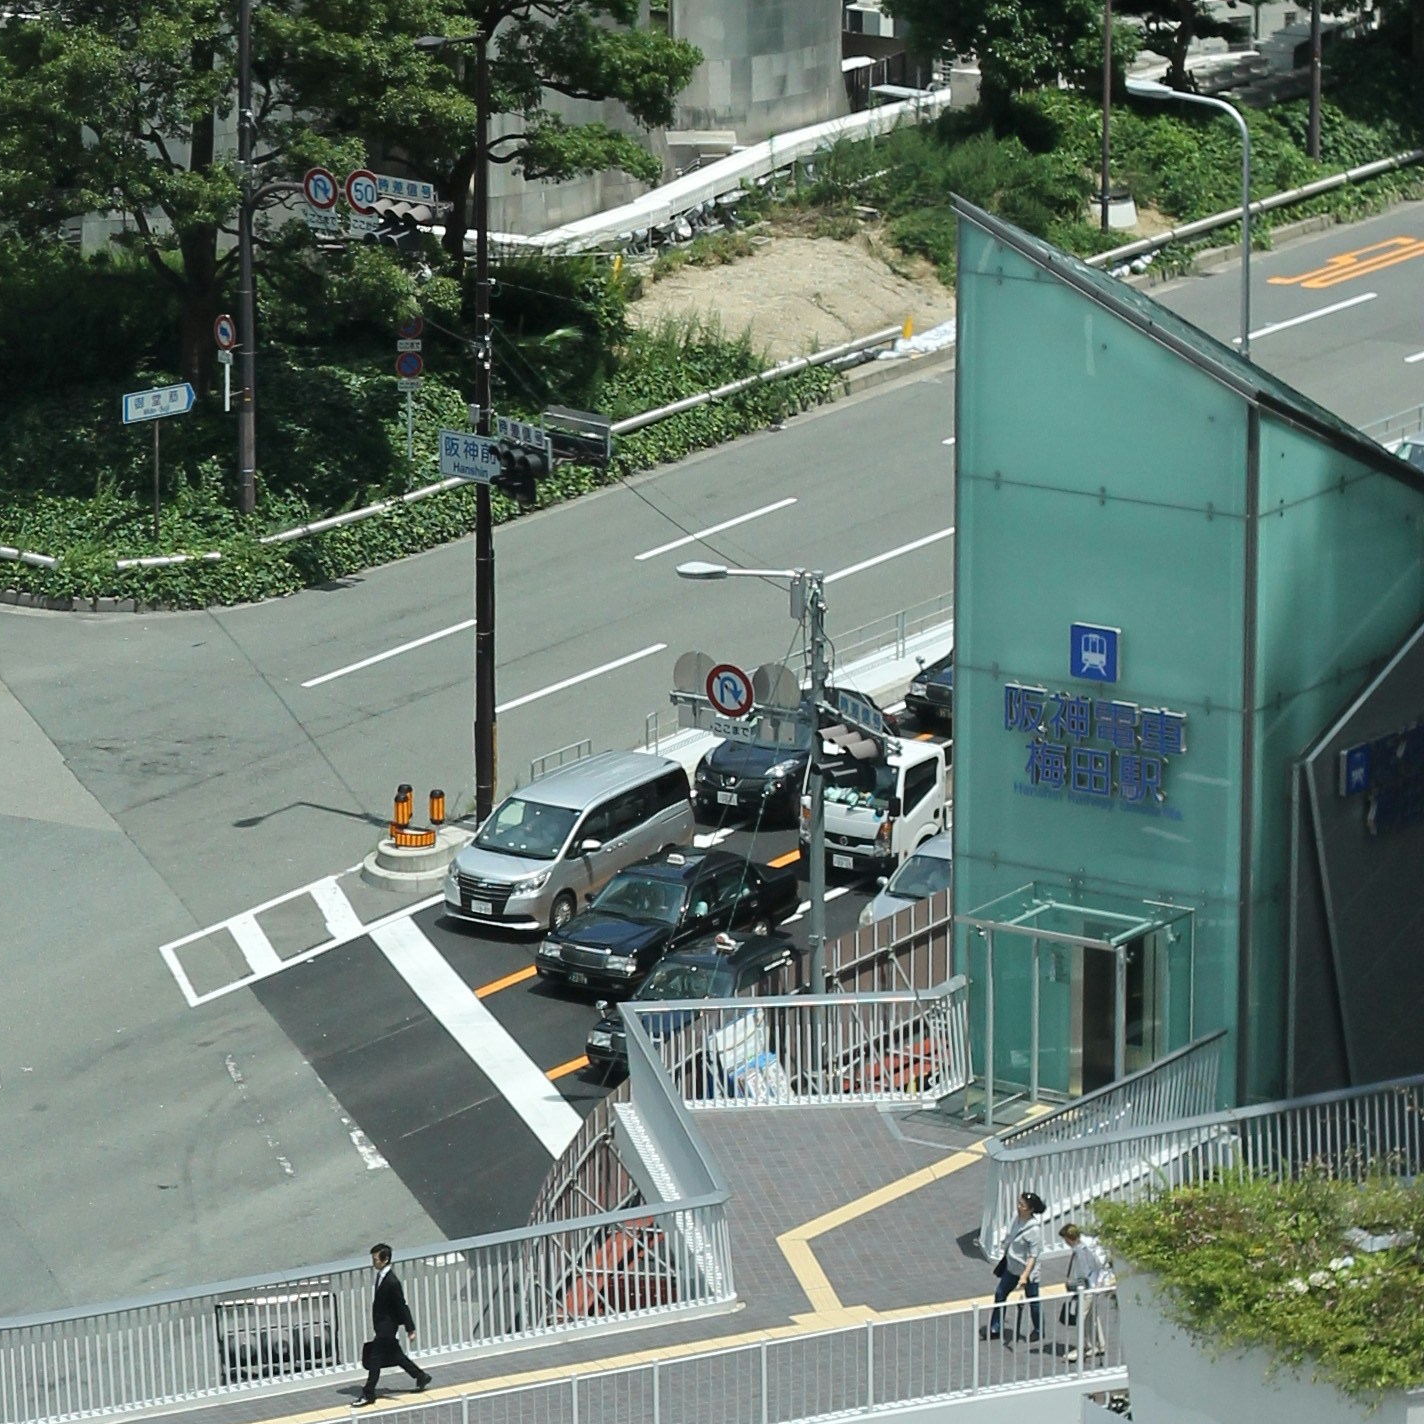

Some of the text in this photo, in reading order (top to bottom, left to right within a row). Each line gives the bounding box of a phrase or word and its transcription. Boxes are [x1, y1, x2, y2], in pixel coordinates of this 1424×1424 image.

[353, 182, 375, 204] 50
[378, 177, 431, 199] 時差信号
[444, 436, 496, 465] 阪神前
[453, 461, 489, 478] Hanshin
[1004, 682, 1187, 755] 阪神電車
[713, 722, 751, 738] ここまで
[1025, 738, 1168, 802] 梅田駅
